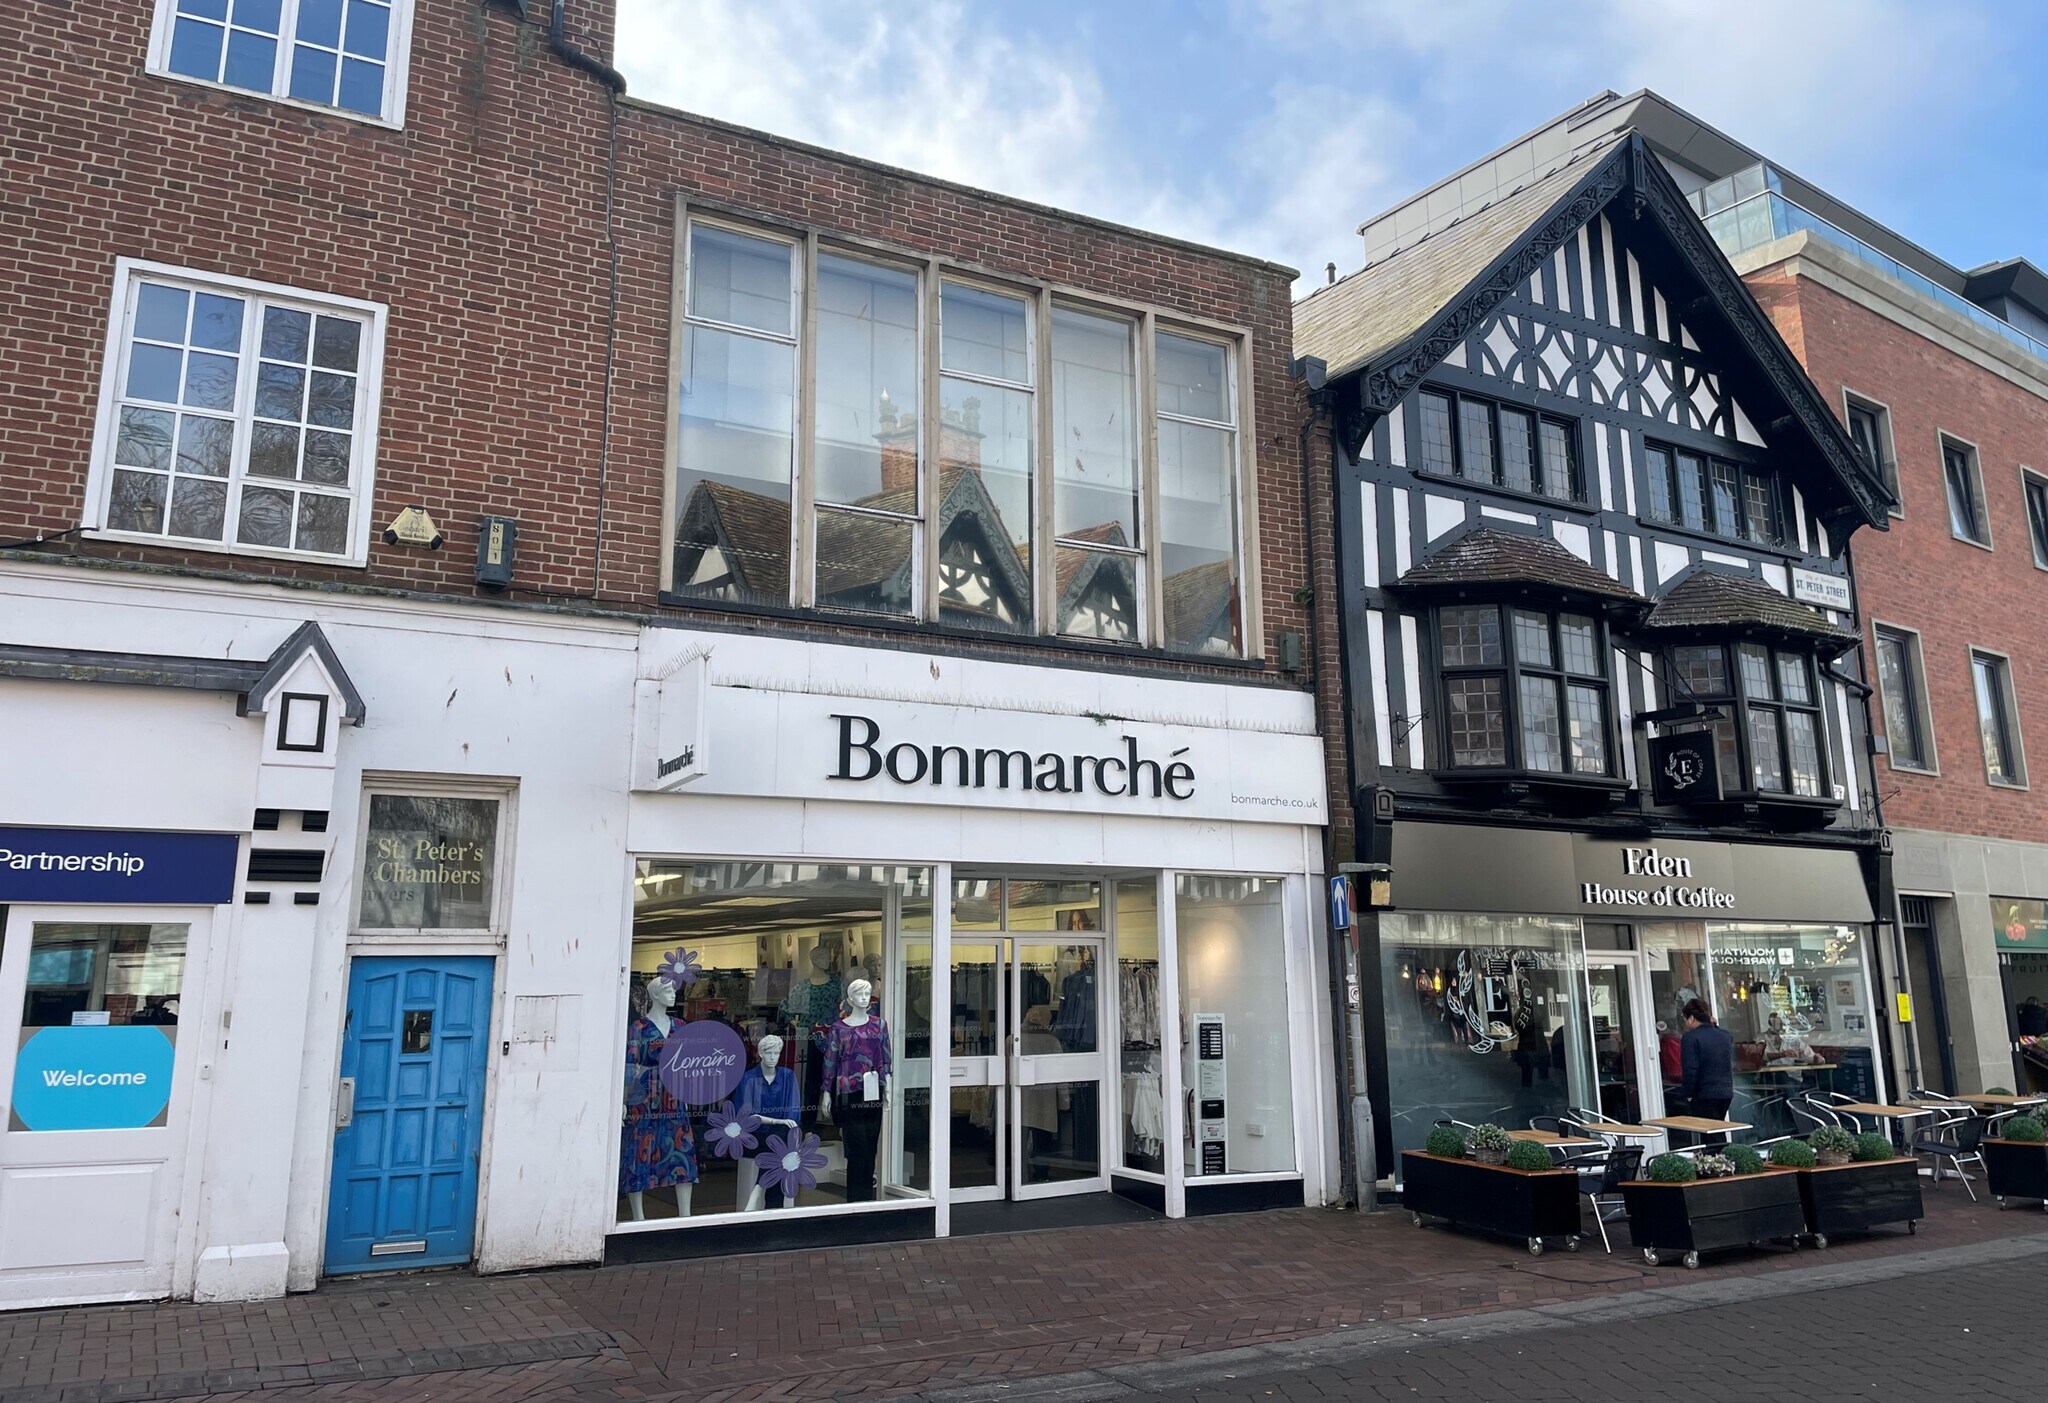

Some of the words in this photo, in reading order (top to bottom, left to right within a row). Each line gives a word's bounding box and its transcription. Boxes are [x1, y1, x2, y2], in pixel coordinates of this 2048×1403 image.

[1795, 579, 1804, 589] ST.
[1806, 581, 1824, 594] PETER
[1826, 585, 1847, 599] STREET
[827, 713, 1195, 800] Bonmarché
[1681, 760, 1693, 774] E
[1231, 792, 1318, 808] bonmarche.co.uk
[0, 849, 145, 876] Partnership
[377, 861, 481, 884] Chambers
[1625, 847, 1693, 878] Eden
[1584, 883, 1649, 906] House
[1653, 885, 1674, 907] of
[1677, 886, 1735, 909] Coffee
[662, 1042, 737, 1073] Lorraine
[42, 1069, 147, 1087] Welcome
[684, 1068, 722, 1078] LOVES
